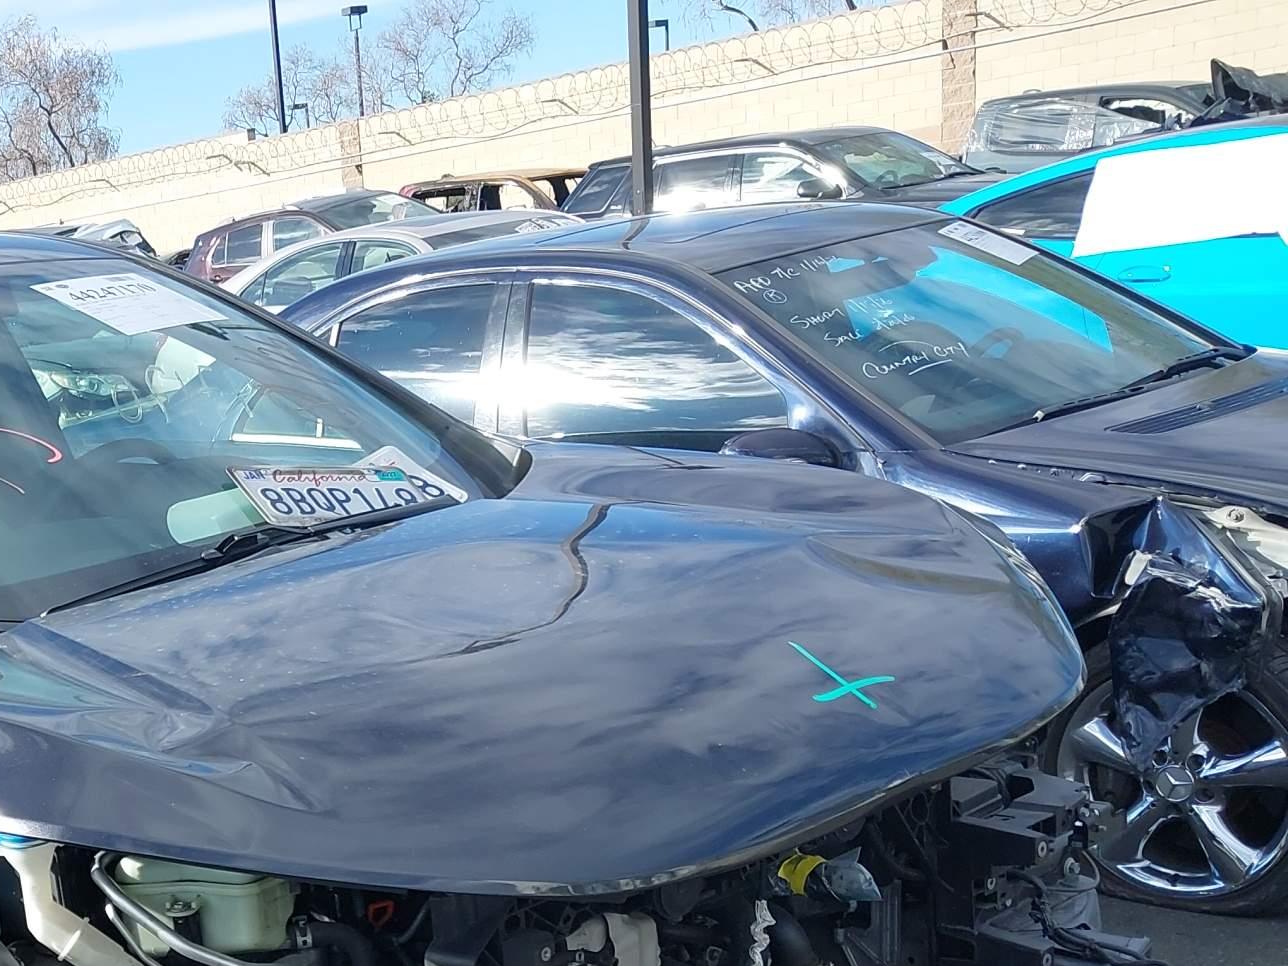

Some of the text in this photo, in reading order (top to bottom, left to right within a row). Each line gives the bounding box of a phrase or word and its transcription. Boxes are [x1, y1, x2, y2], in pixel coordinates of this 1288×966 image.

[68, 282, 157, 304] 44247170
[243, 470, 266, 481] JAN
[272, 468, 368, 487] California
